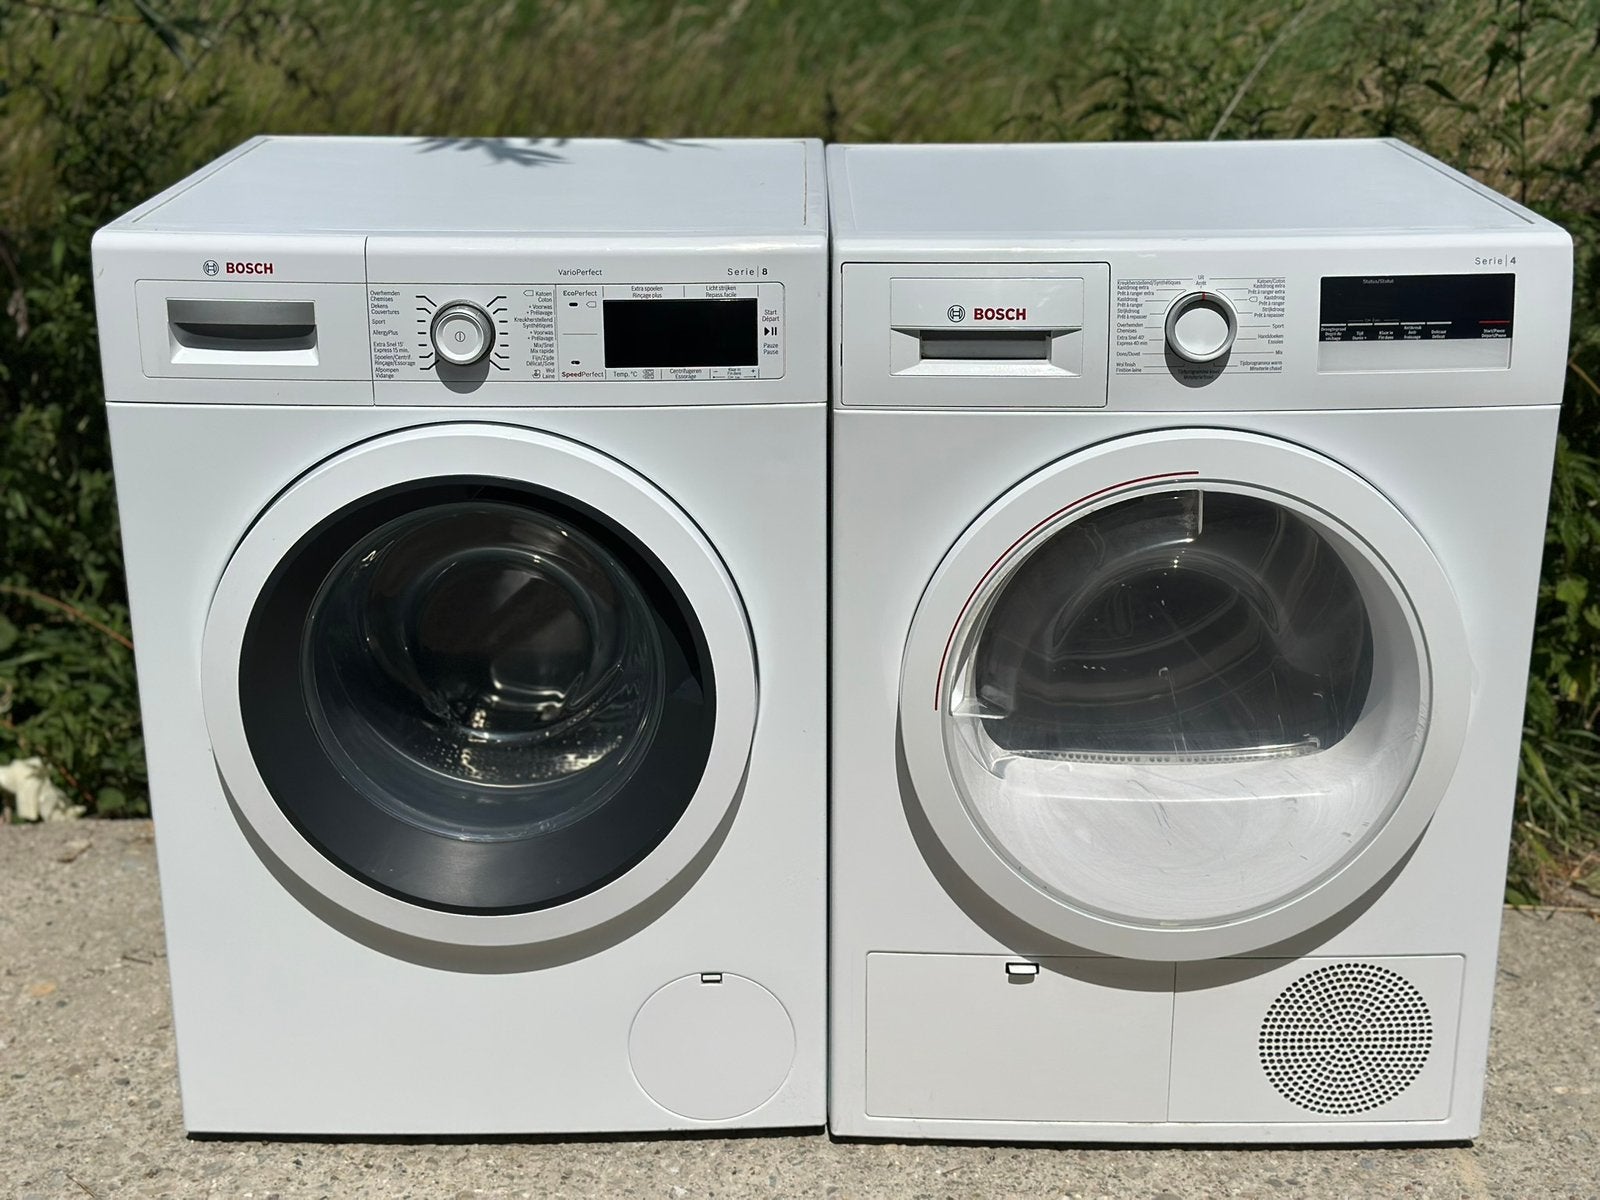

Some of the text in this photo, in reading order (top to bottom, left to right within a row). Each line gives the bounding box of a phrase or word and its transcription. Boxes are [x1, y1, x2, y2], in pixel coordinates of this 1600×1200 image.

[1475, 257, 1517, 265] Serie 4
[226, 262, 273, 274] BOSCH
[558, 268, 603, 276] VarioPerfect
[727, 267, 768, 276] Serie 8
[974, 308, 1026, 320] BOSCH
